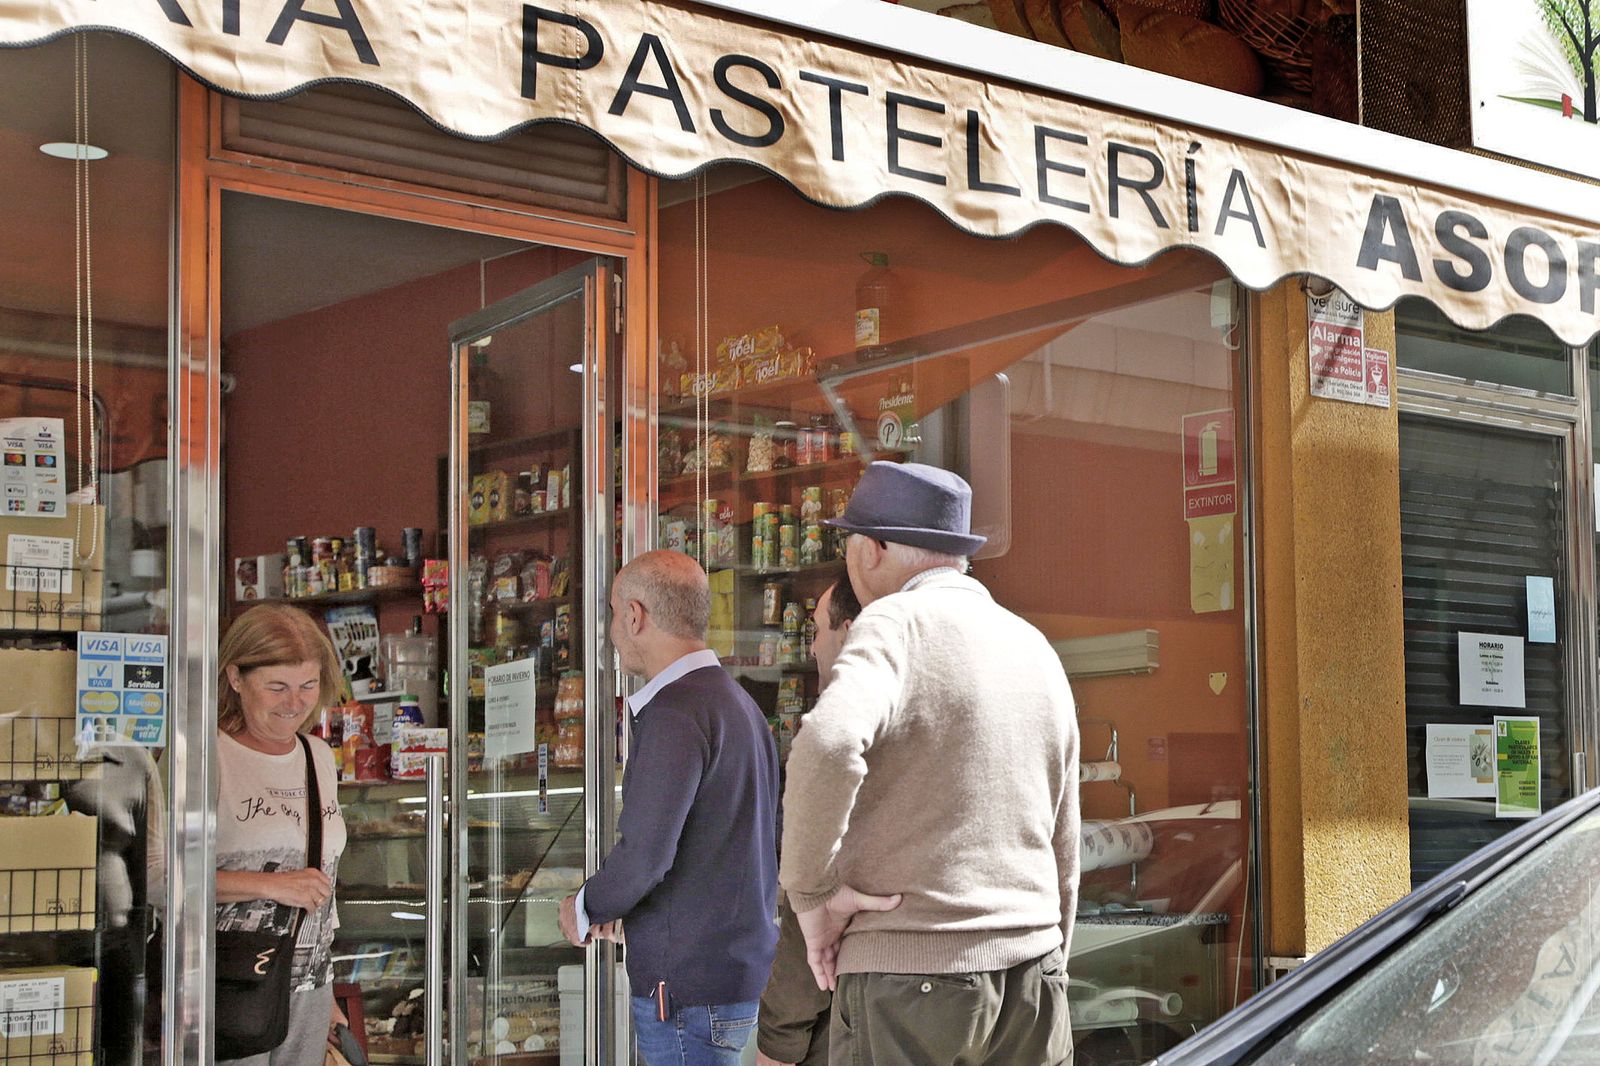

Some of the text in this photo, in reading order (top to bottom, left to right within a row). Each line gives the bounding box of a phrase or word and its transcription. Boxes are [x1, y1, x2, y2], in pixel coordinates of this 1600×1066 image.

[521, 4, 1266, 248] PASTELERÍA
[1312, 325, 1361, 347] Alarma
[1188, 494, 1233, 509] EXTINTOR
[86, 639, 162, 654] VISA VISA
[127, 680, 161, 689] ServiRed
[236, 796, 277, 823] The
